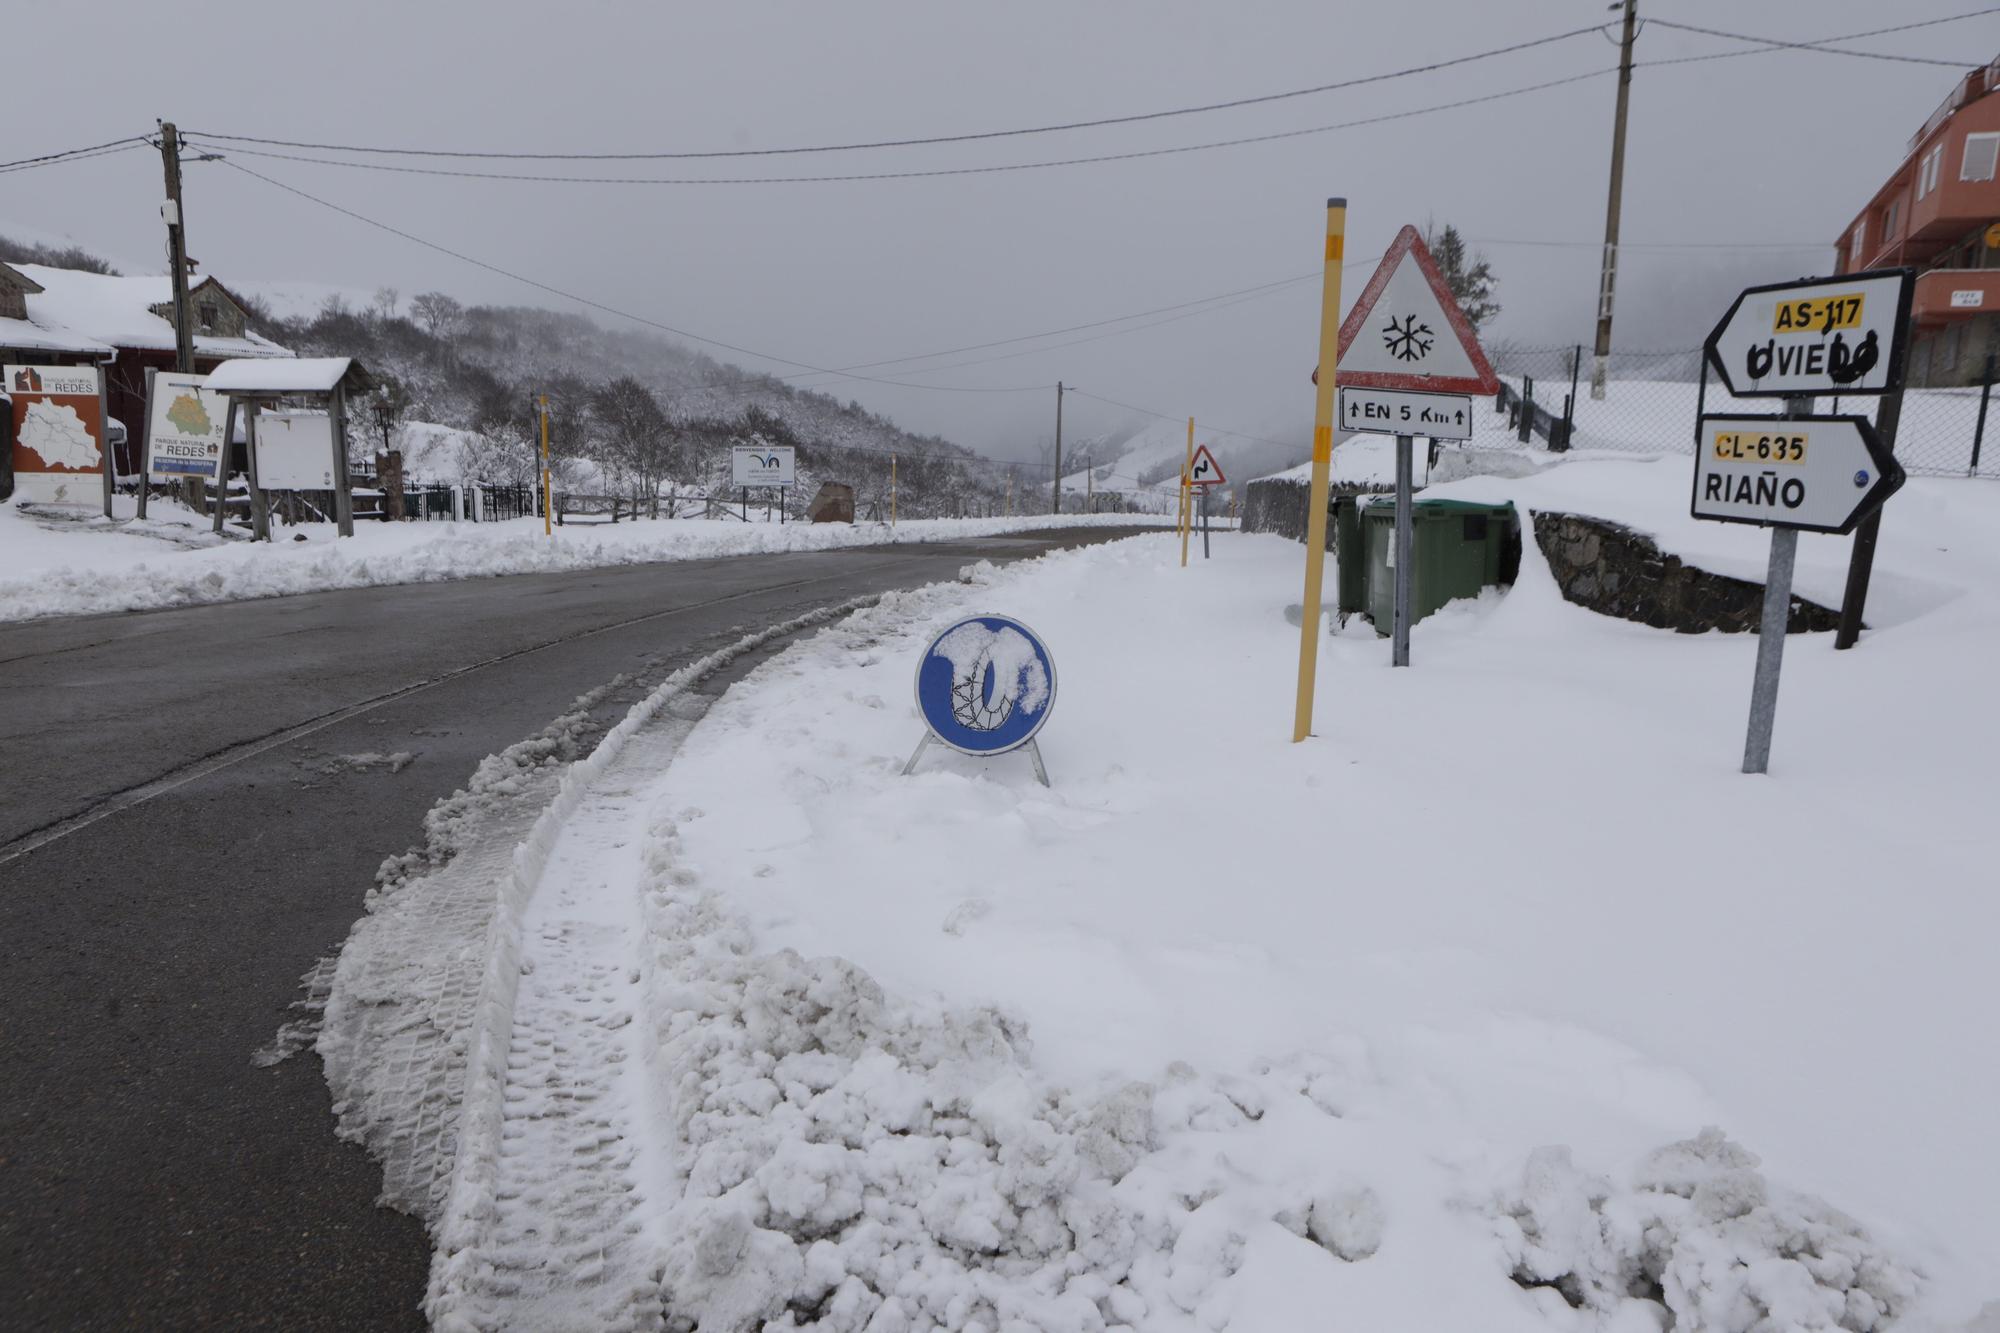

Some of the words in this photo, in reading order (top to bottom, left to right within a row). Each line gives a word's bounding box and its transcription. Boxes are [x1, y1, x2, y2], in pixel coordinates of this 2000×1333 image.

[1776, 298, 1861, 330] AS-117
[55, 383, 93, 393] REDES
[1364, 402, 1390, 419] EN
[1400, 405, 1411, 421] 5
[1420, 407, 1449, 423] Km
[166, 445, 205, 457] REDES
[1716, 435, 1804, 461] CL-635
[1705, 471, 1805, 509] RIAÑO
